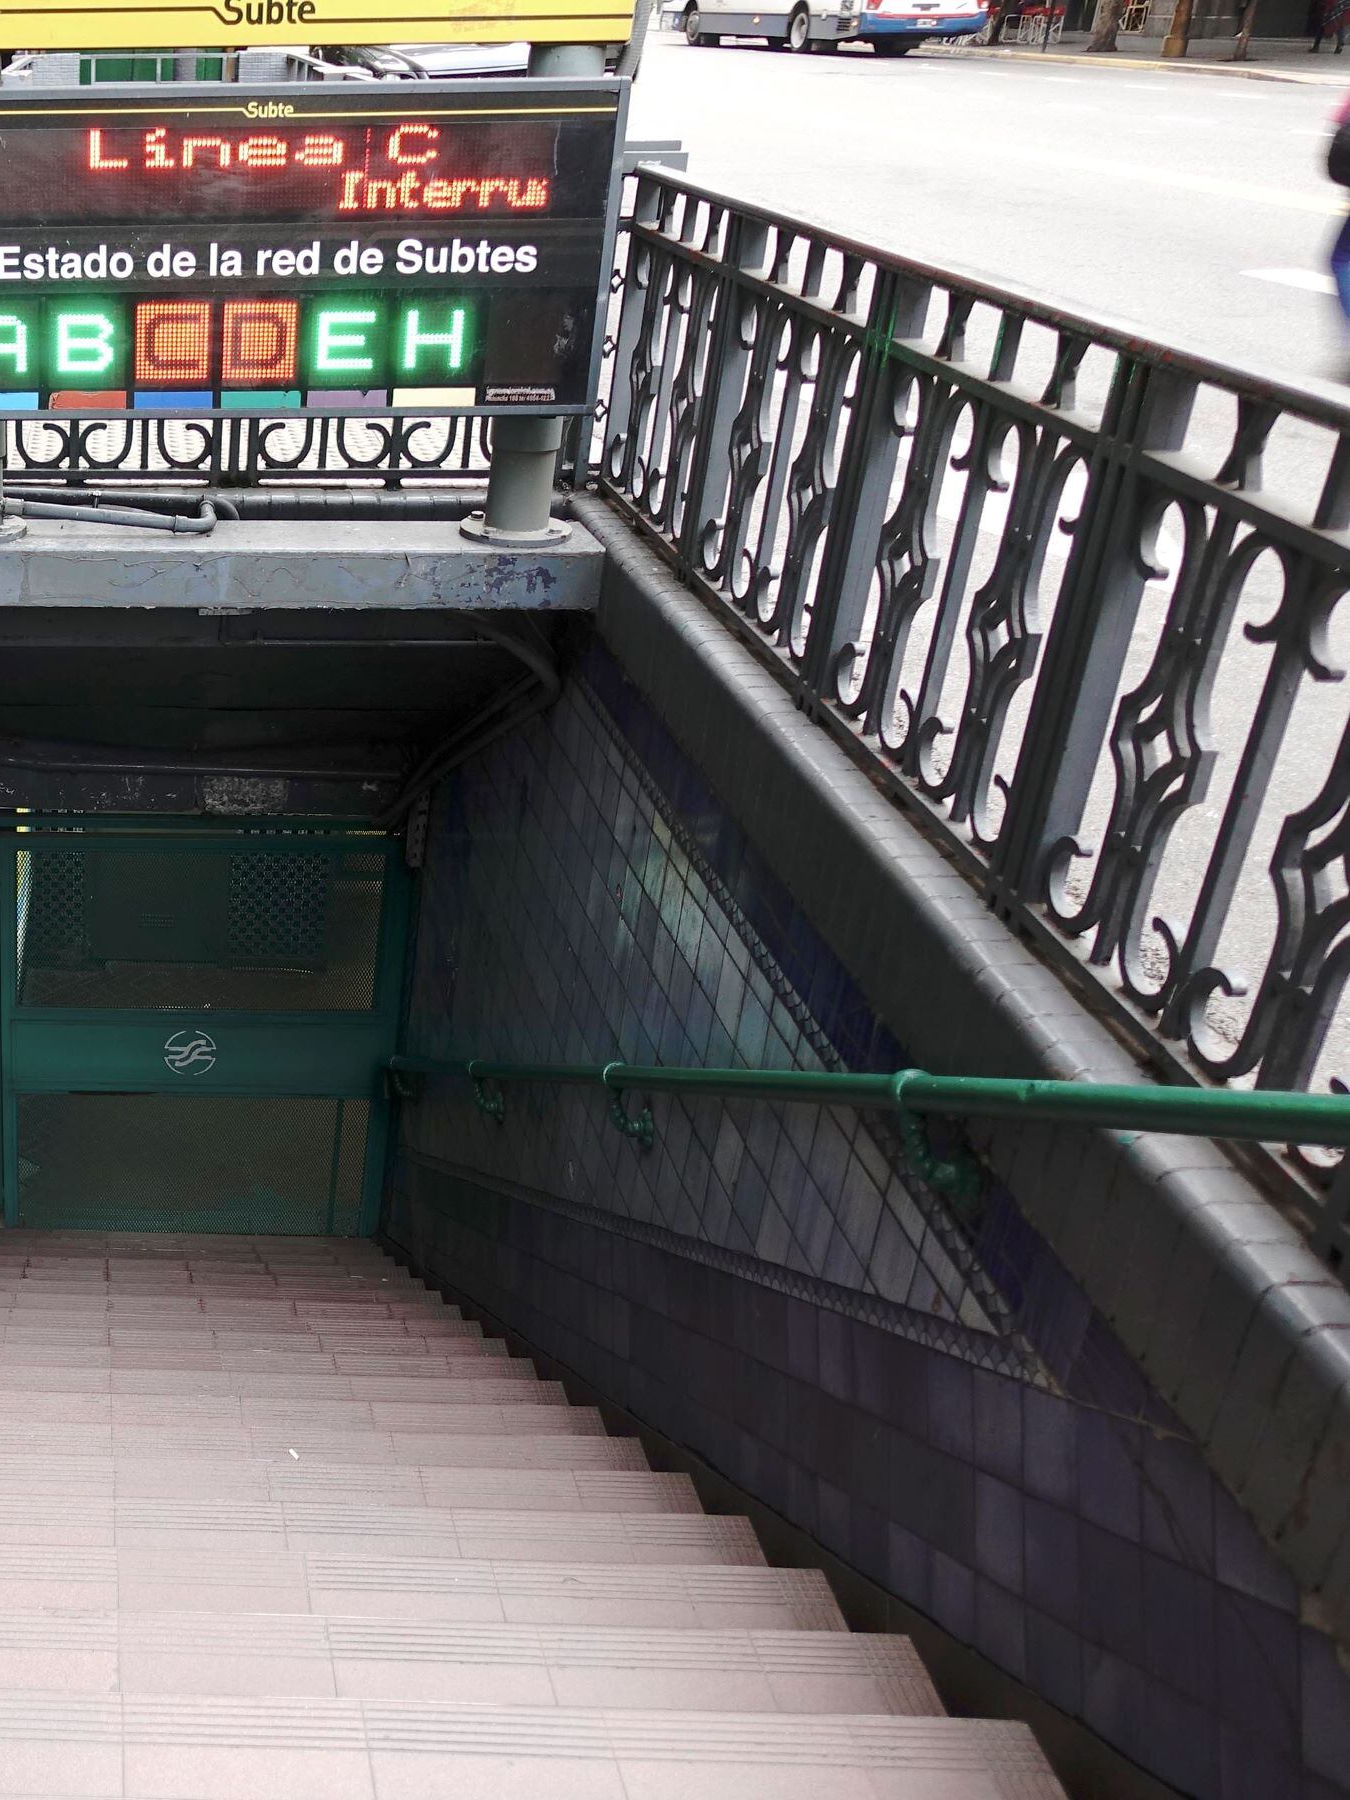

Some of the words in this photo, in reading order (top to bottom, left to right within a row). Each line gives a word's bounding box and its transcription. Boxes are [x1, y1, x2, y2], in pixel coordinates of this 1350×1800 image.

[222, 0, 316, 26] Subte
[247, 101, 294, 118] Subte
[388, 123, 439, 165] C
[147, 243, 196, 277] de
[209, 243, 242, 276] la
[256, 241, 320, 276] red
[333, 240, 384, 275] de
[395, 238, 538, 274] Subtes
[56, 313, 115, 372] B
[148, 315, 202, 371] C
[233, 313, 288, 370] D
[317, 310, 376, 369] E
[403, 309, 465, 369] H
